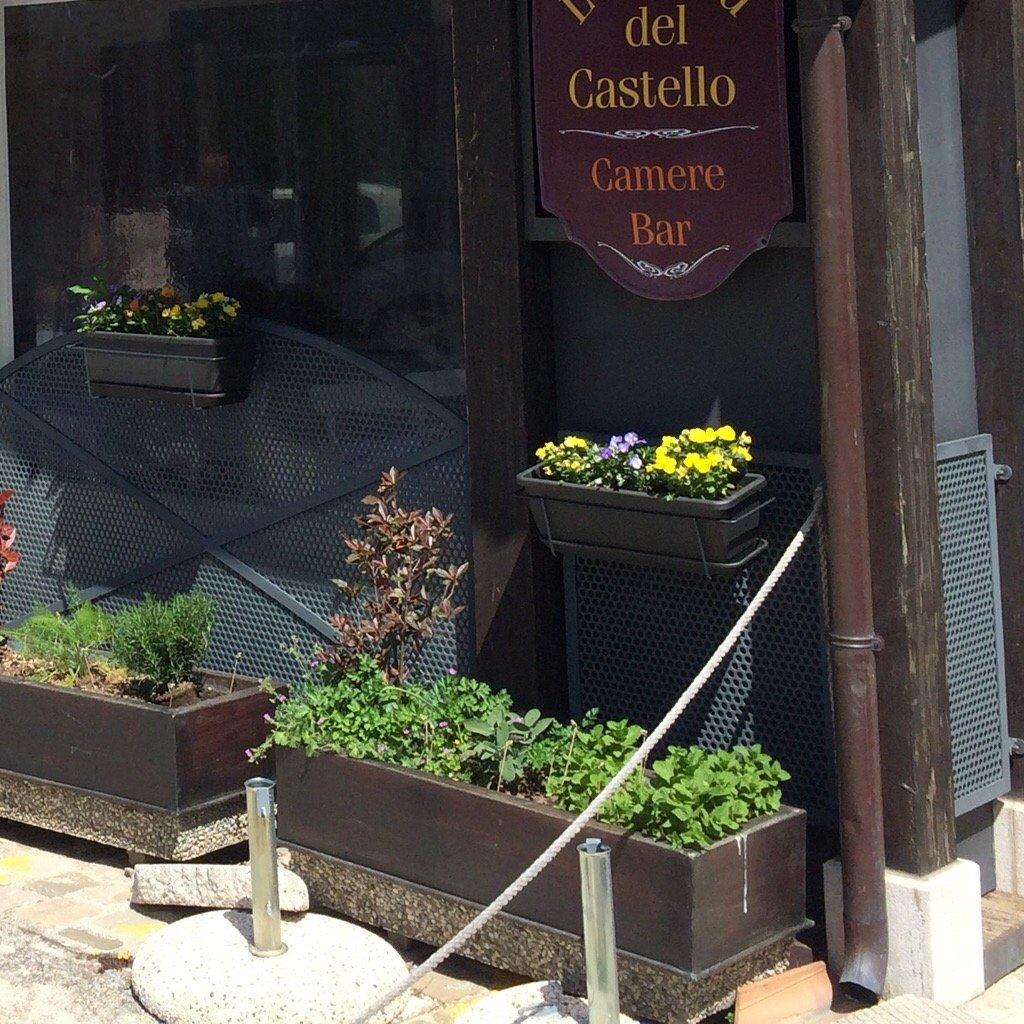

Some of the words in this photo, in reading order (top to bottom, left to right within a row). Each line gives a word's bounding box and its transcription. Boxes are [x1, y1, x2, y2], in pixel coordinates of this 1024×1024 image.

[625, 4, 688, 47] del
[569, 66, 736, 109] Castello
[591, 157, 725, 192] Camere
[630, 212, 692, 247] Bar
